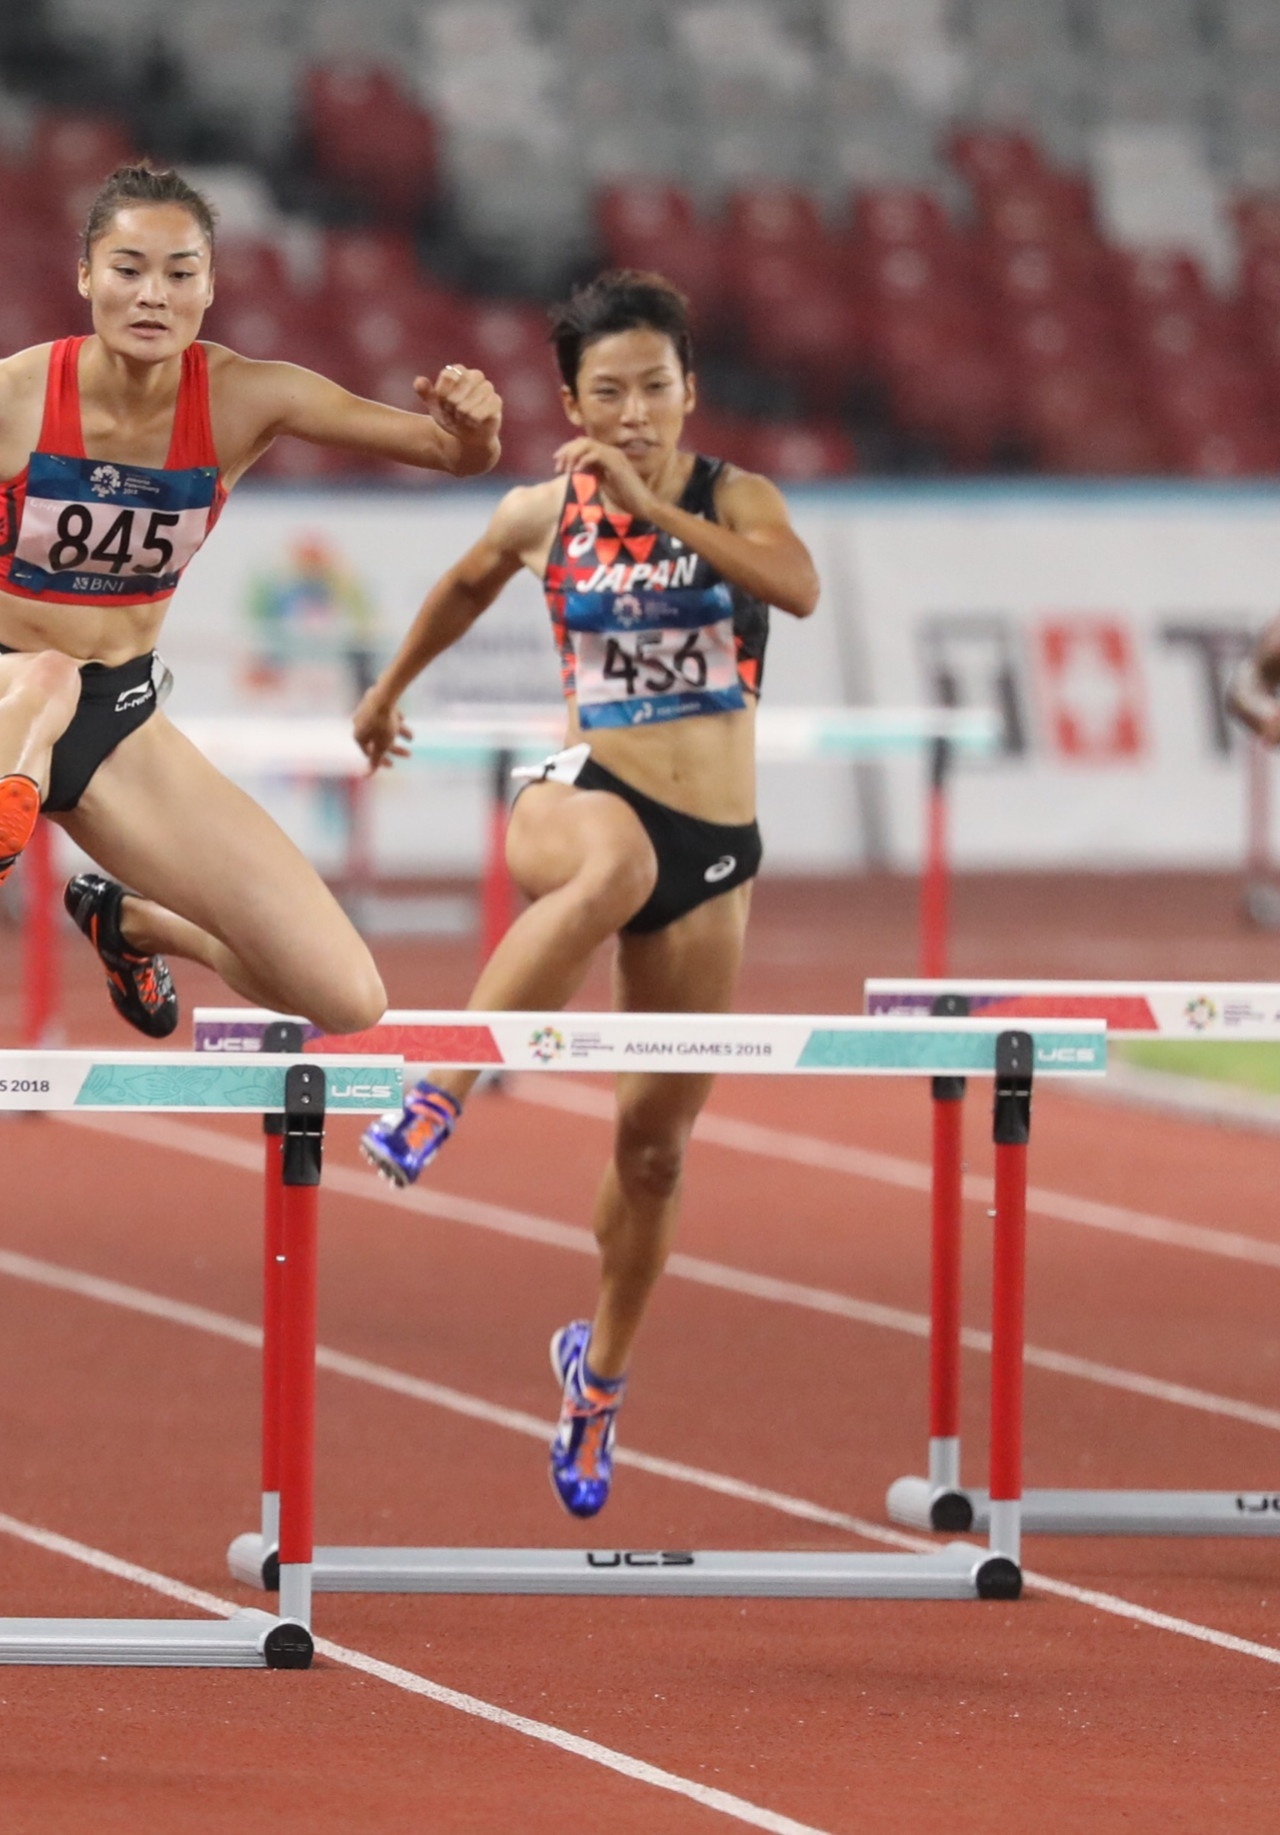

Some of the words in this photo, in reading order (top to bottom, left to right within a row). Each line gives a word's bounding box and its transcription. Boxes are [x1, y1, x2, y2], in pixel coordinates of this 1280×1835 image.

[48, 503, 180, 574] 845
[576, 553, 699, 593] JAPAN
[90, 578, 124, 592] BNI
[603, 632, 708, 695] 456
[204, 1037, 261, 1051] UCS
[624, 1042, 673, 1055] ASIAN
[676, 1042, 732, 1056] GAMES
[735, 1043, 772, 1056] 2018
[1037, 1048, 1095, 1062] UCS
[11, 1080, 50, 1093] 2018
[331, 1085, 392, 1098] UCS
[587, 1551, 694, 1566] UCS
